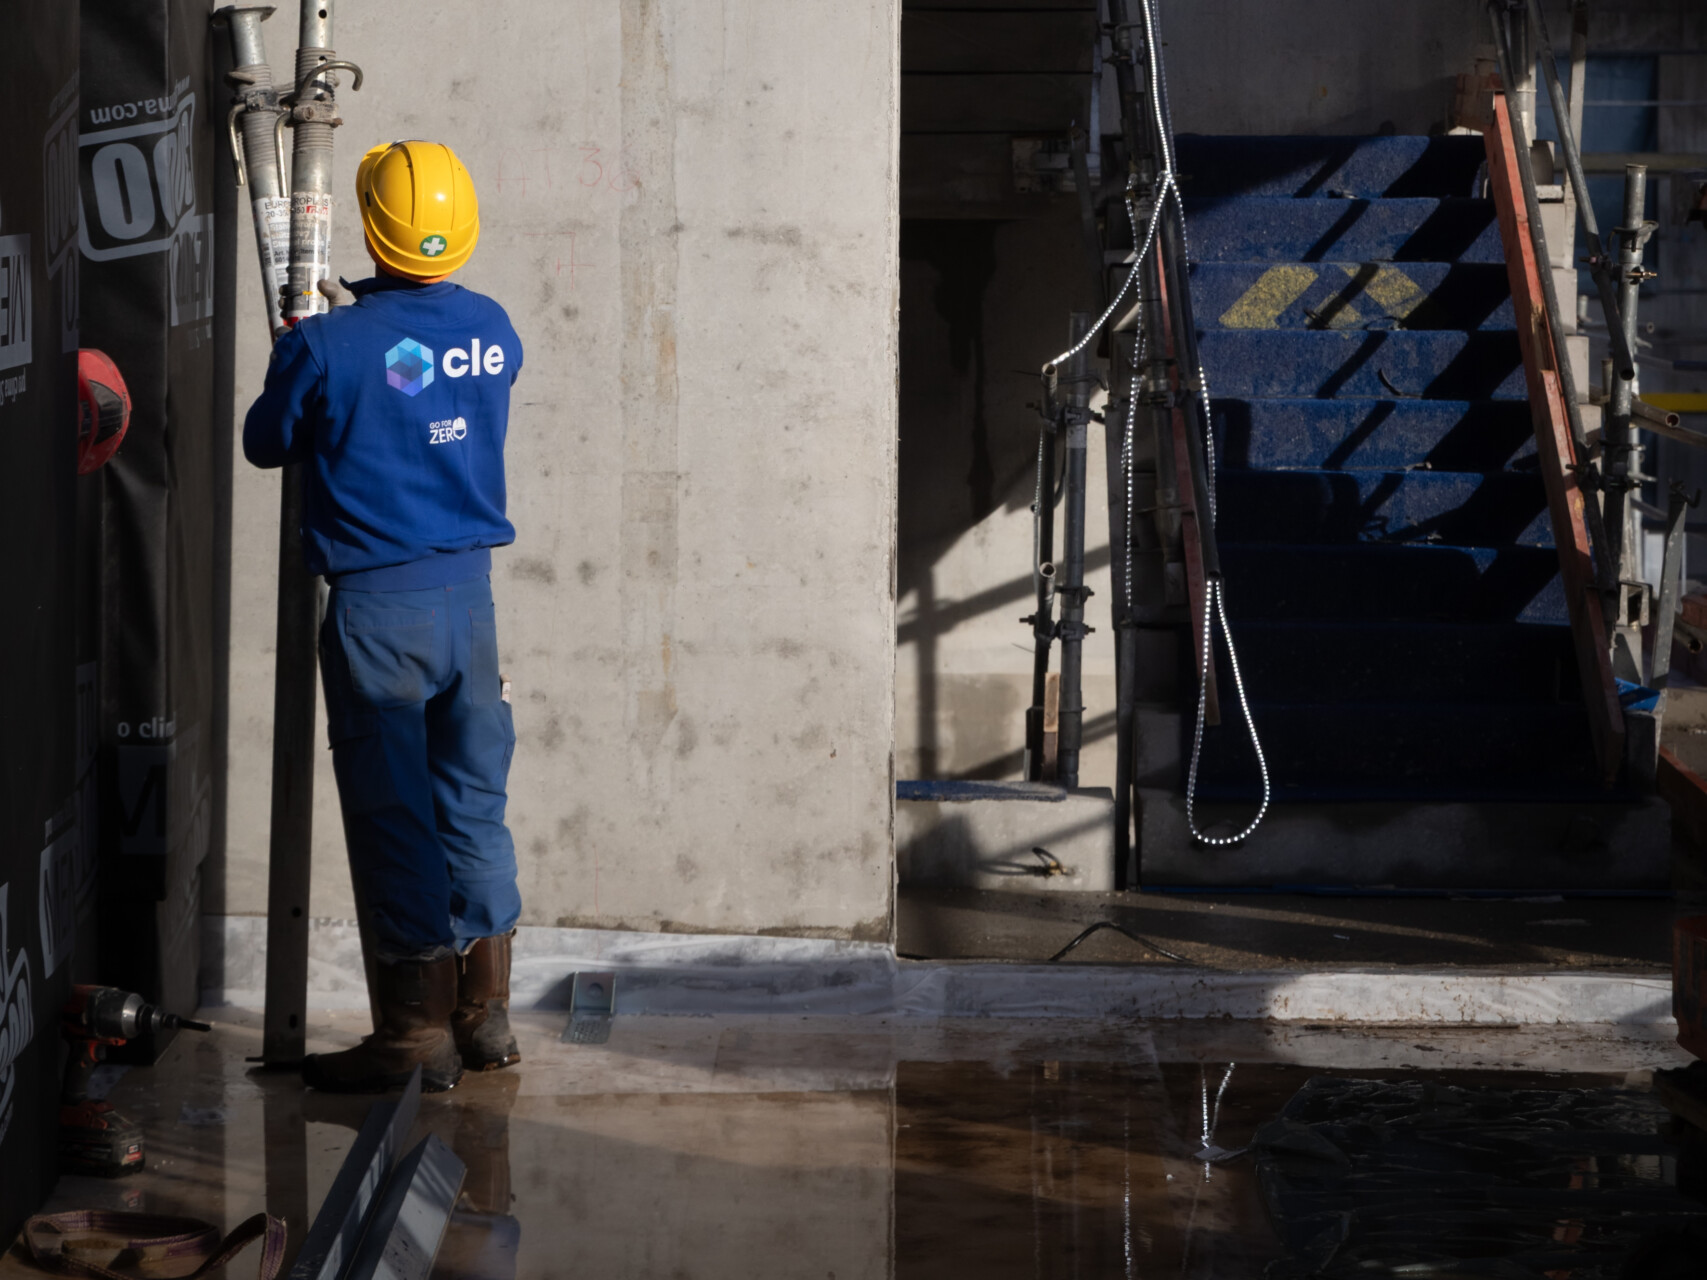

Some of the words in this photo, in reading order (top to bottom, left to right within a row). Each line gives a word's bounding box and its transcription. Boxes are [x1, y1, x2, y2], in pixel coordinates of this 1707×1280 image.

[442, 337, 505, 378] cle
[429, 421, 440, 429] GO
[441, 419, 452, 428] FOR
